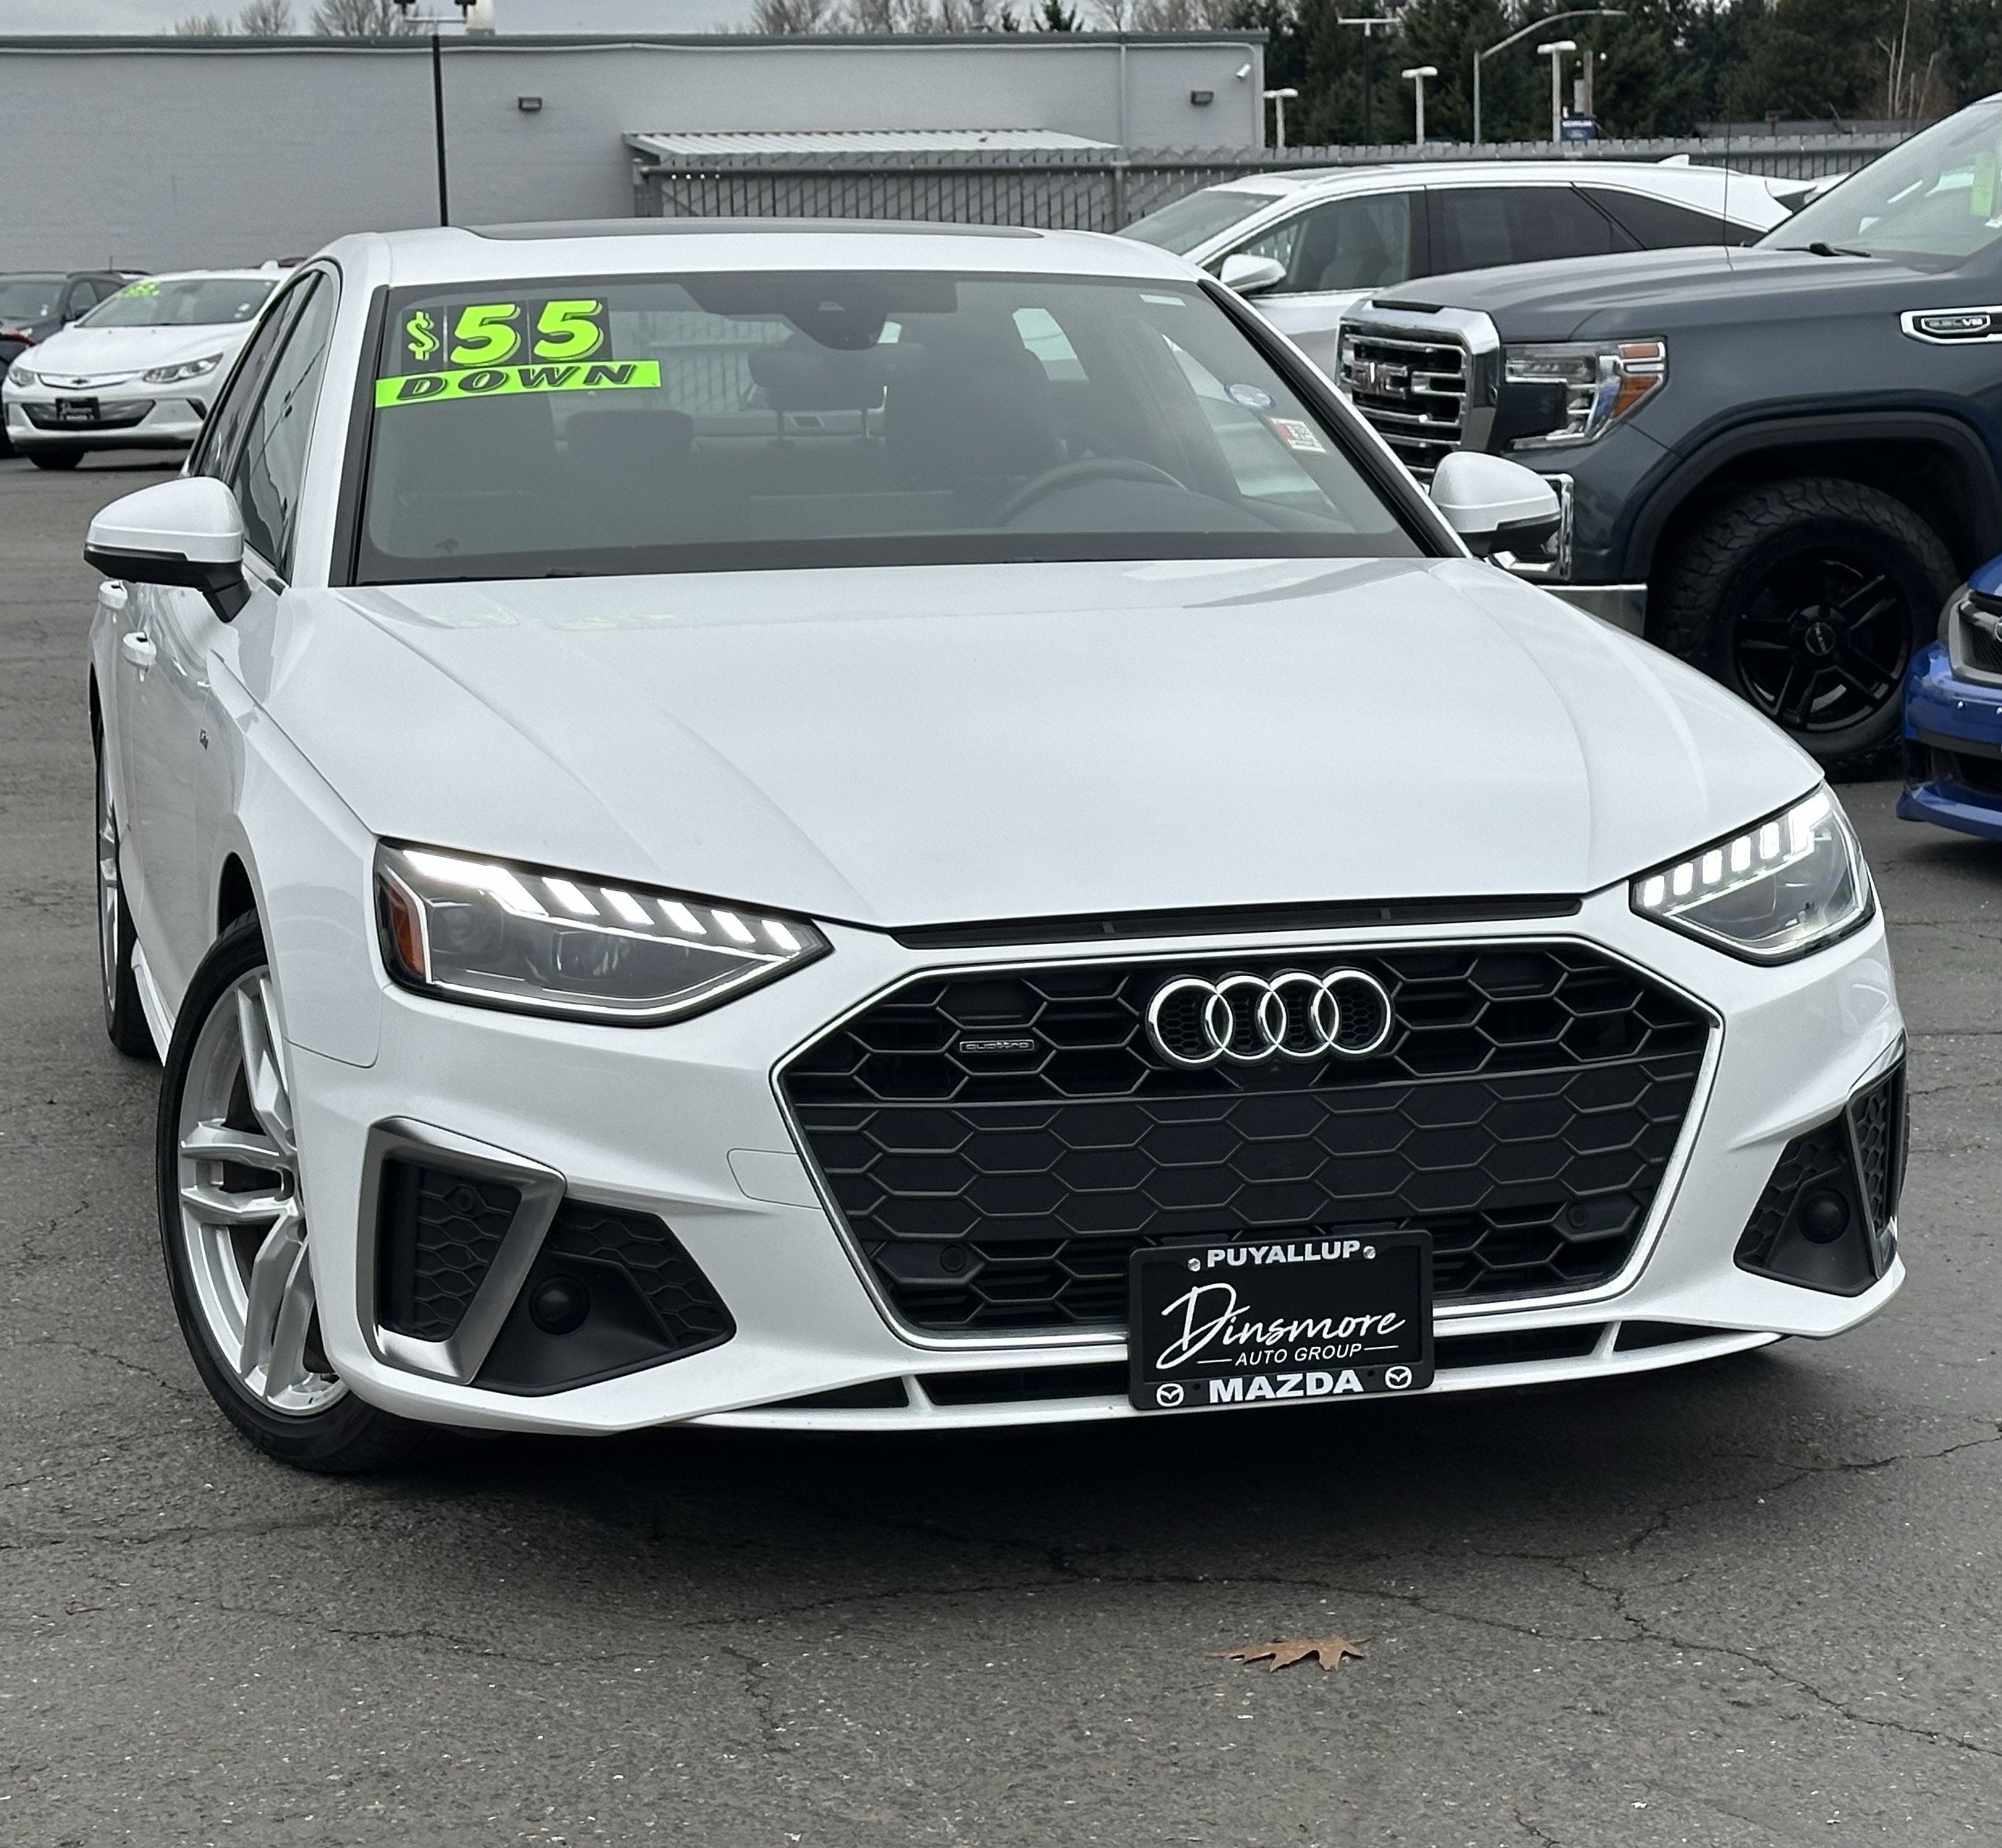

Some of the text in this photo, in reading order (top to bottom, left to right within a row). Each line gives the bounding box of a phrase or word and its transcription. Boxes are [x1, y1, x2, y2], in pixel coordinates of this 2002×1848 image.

[406, 298, 604, 367] $55
[395, 364, 639, 401] DOWN
[1207, 1240, 1360, 1268] PUYALLUP
[1156, 1283, 1406, 1370] Dinsmore
[1234, 1343, 1362, 1366] AUTO GROUP
[1208, 1370, 1364, 1404] MAZDA
